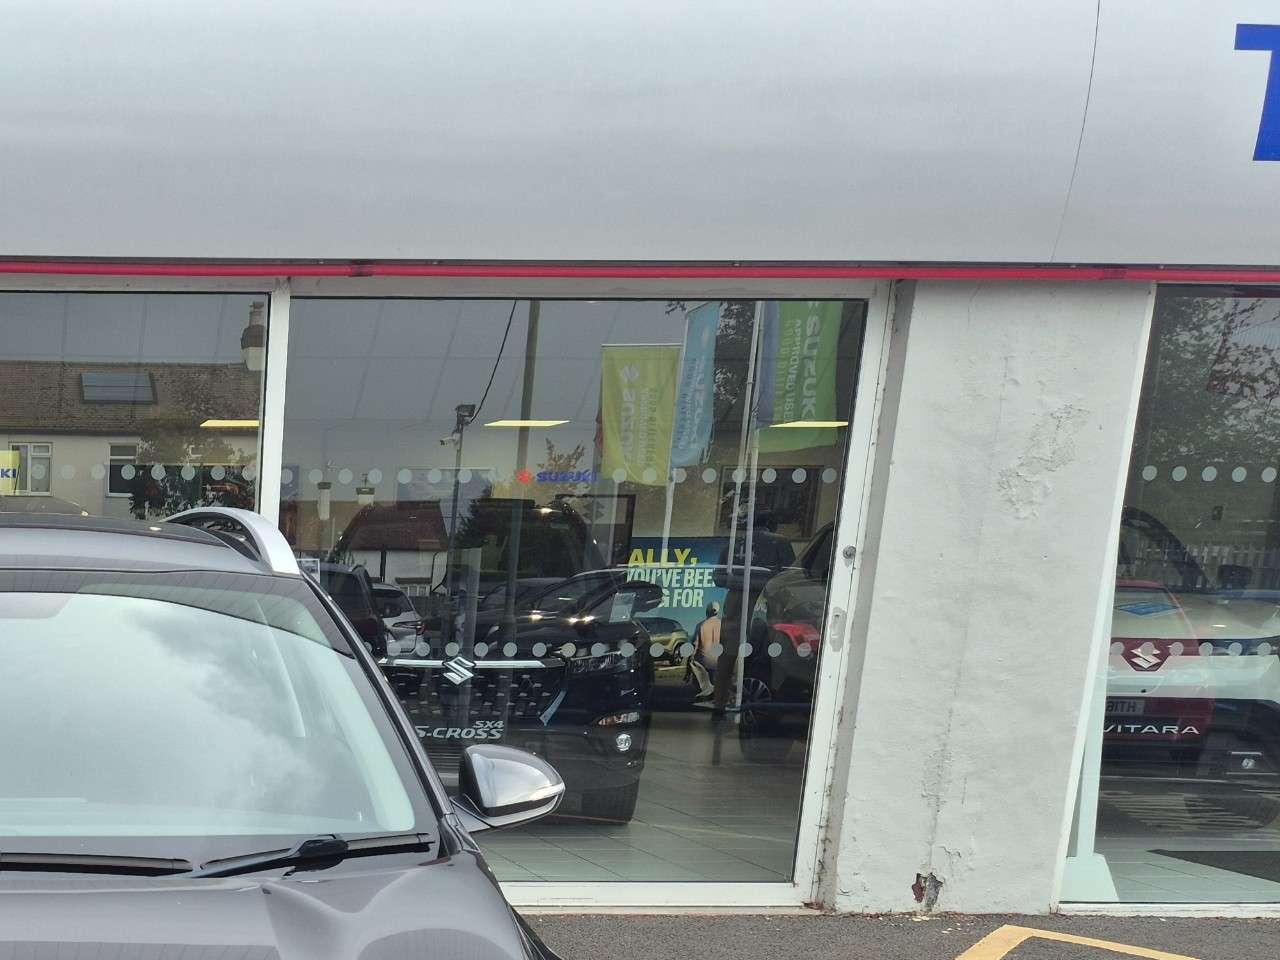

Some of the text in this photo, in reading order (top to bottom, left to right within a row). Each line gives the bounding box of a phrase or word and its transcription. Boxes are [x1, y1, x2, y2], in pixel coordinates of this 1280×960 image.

[800, 315, 820, 418] SUZUK
[683, 568, 716, 587] BEE
[672, 588, 704, 607] FOR
[415, 726, 504, 739] S-CROSS
[472, 720, 505, 729] SX4
[1104, 725, 1200, 734] VITARA
